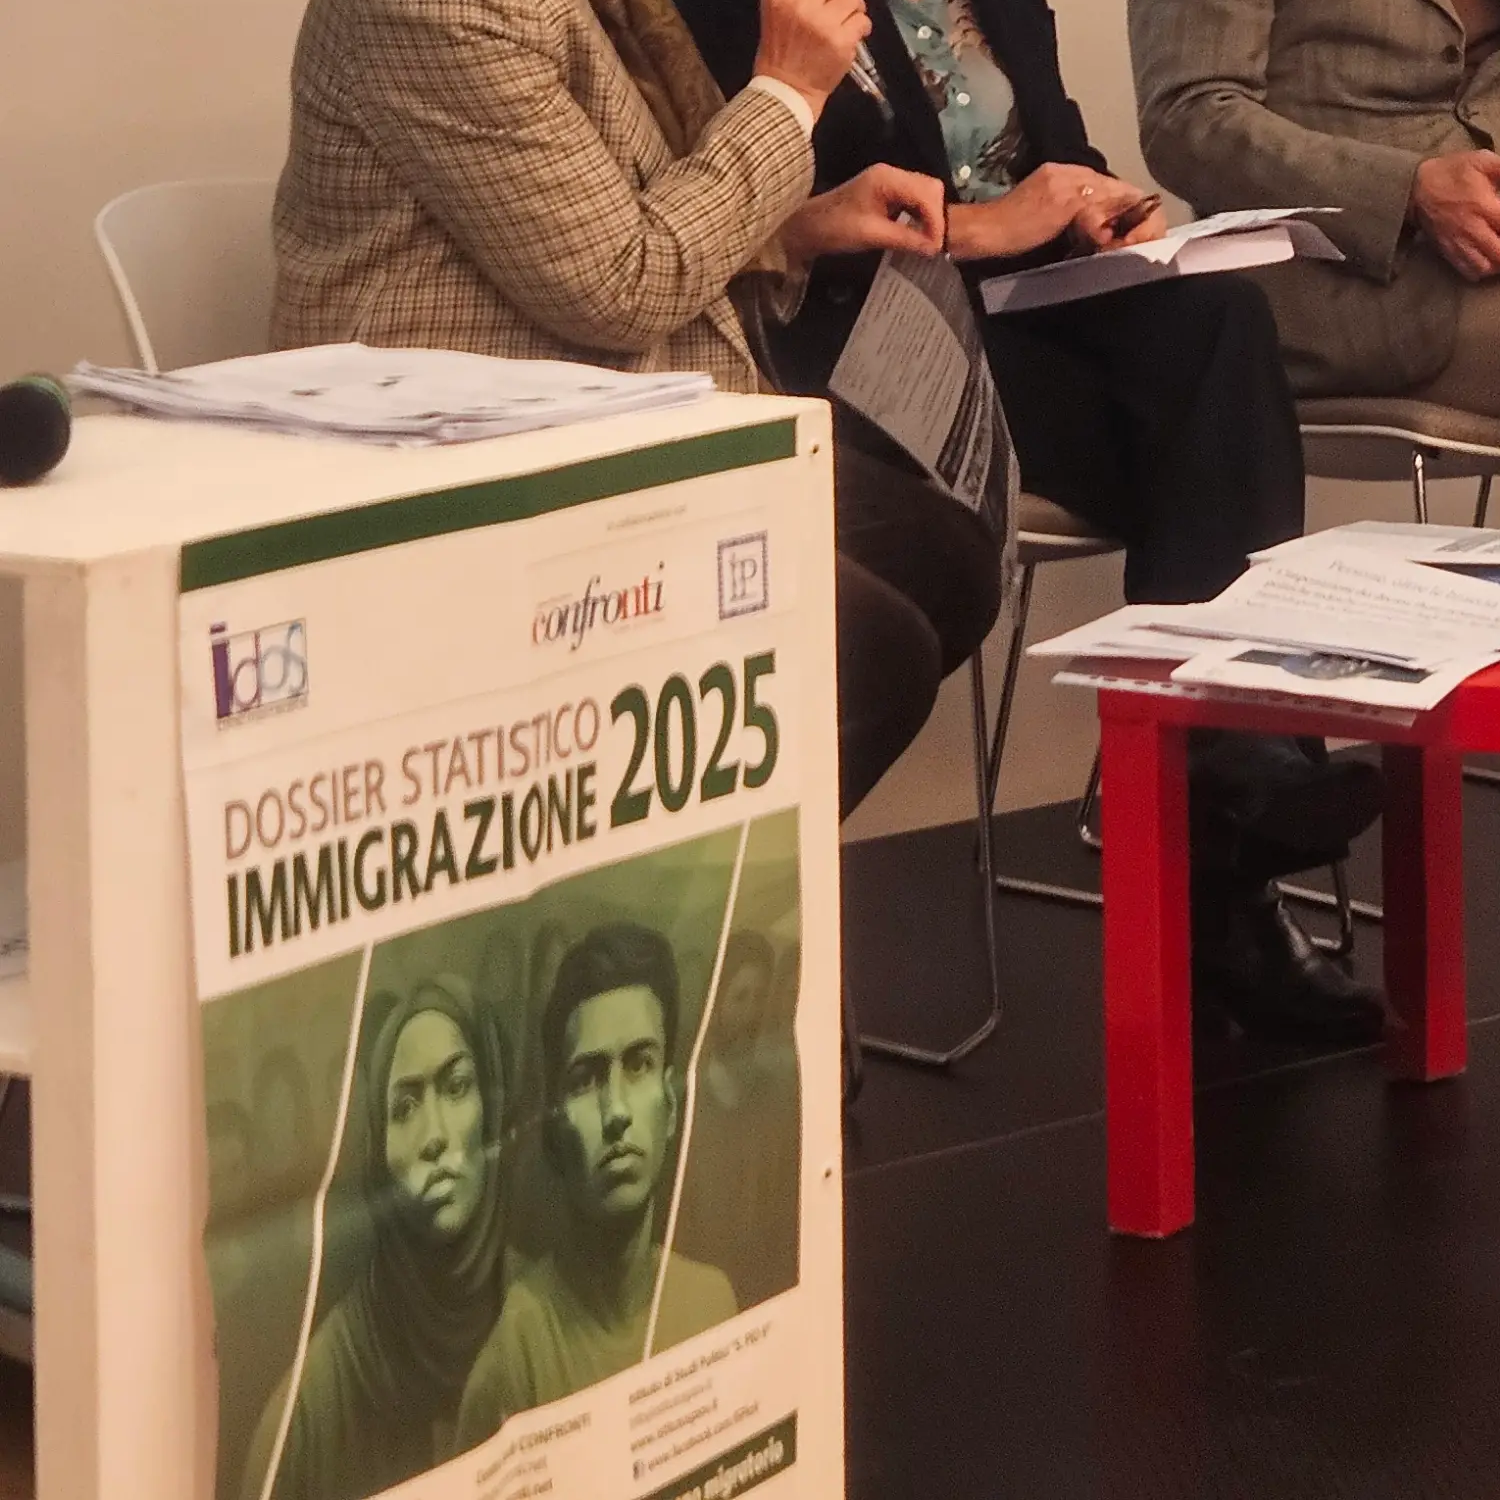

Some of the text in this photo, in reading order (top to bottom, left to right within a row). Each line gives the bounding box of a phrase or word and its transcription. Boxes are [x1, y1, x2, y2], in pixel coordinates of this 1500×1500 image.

[532, 561, 666, 652] confronti
[224, 697, 601, 859] DOSSIER STATISTICO
[227, 649, 780, 959] IMMIGRAZIONE 2025
